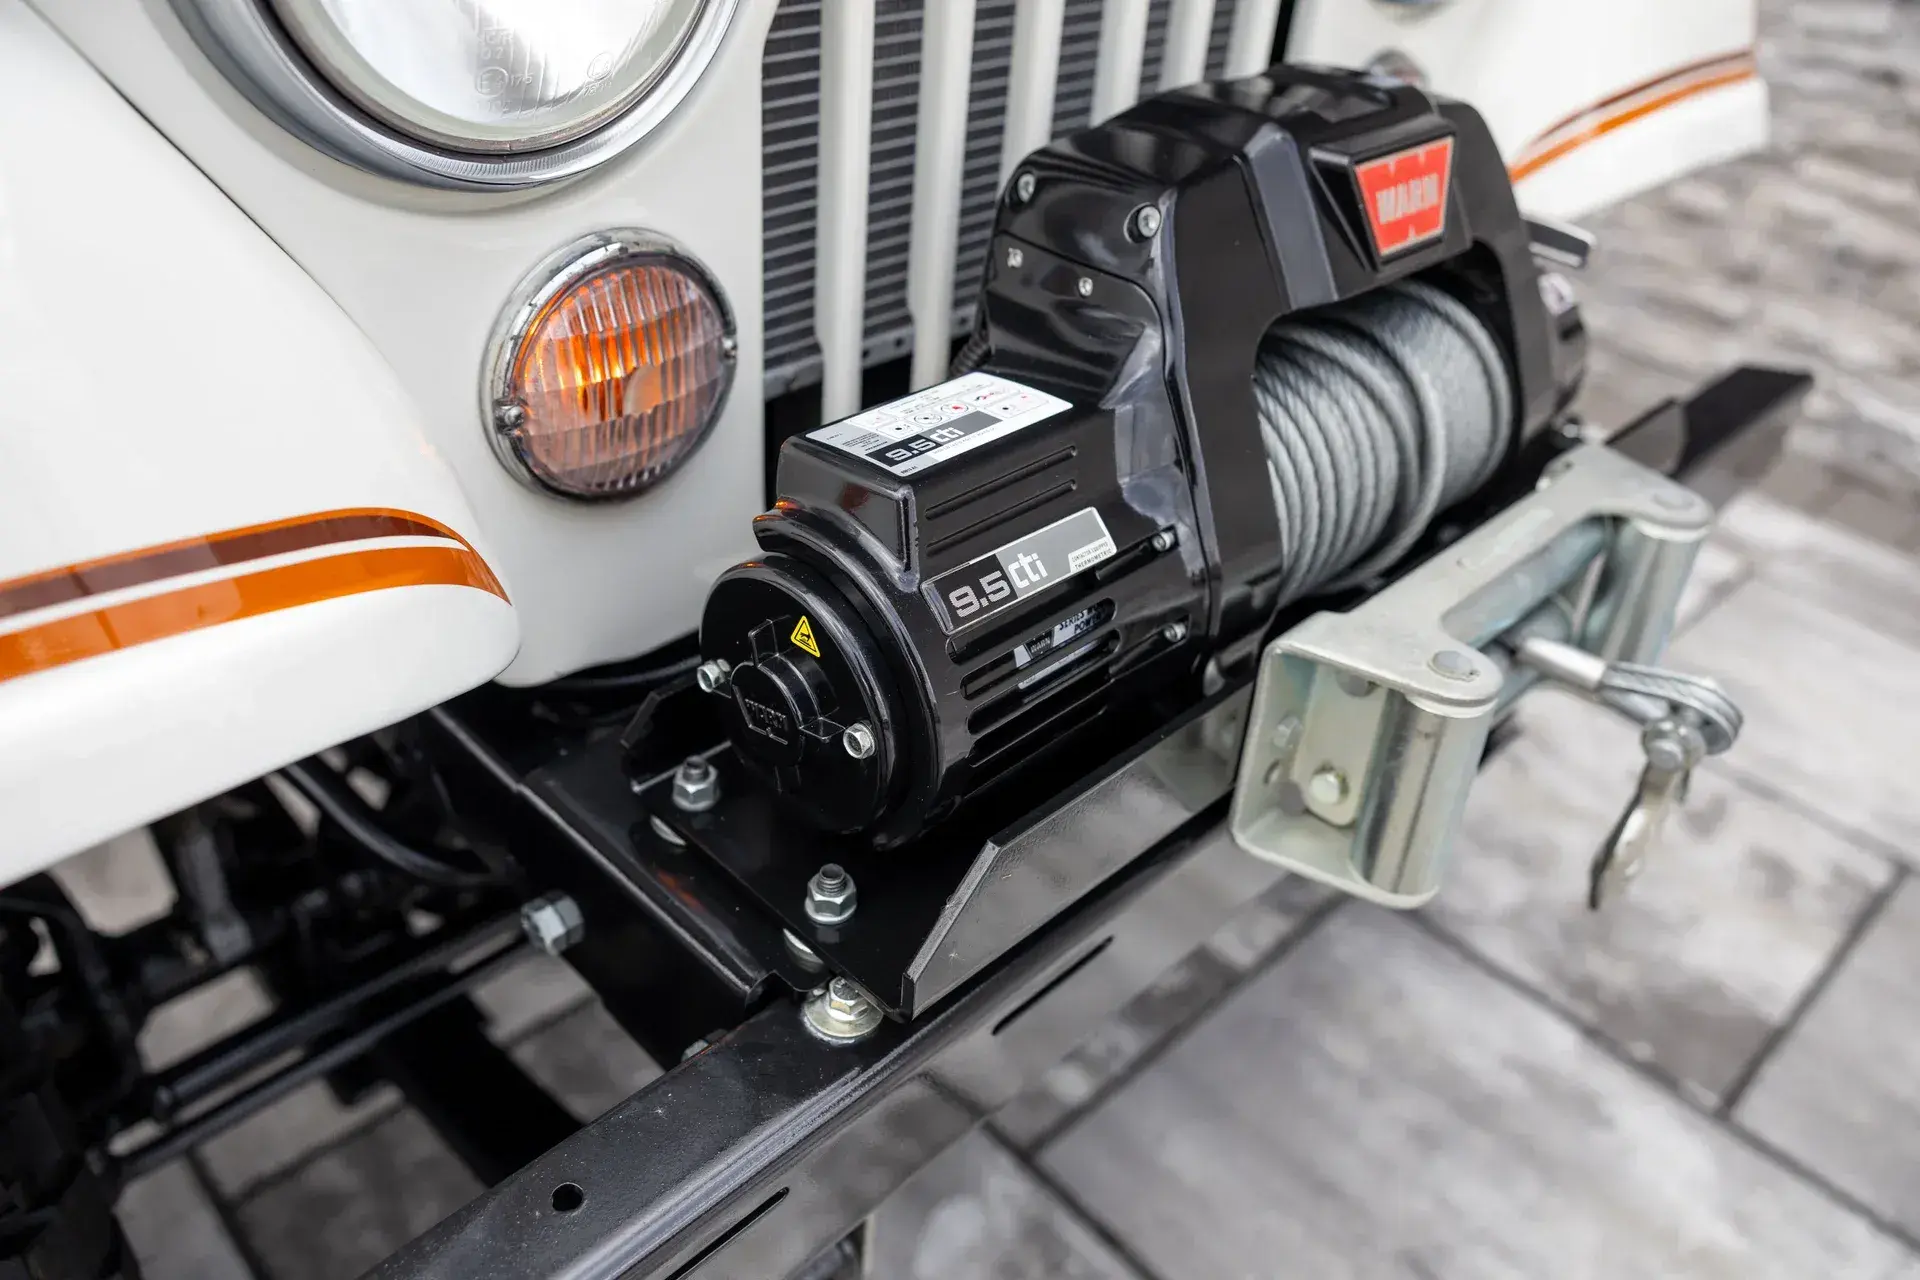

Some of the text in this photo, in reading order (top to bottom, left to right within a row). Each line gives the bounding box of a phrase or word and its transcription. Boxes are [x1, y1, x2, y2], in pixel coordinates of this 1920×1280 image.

[1376, 172, 1440, 224] WARN
[886, 438, 936, 462] 9.5
[948, 552, 1049, 618] 9.5 cti
